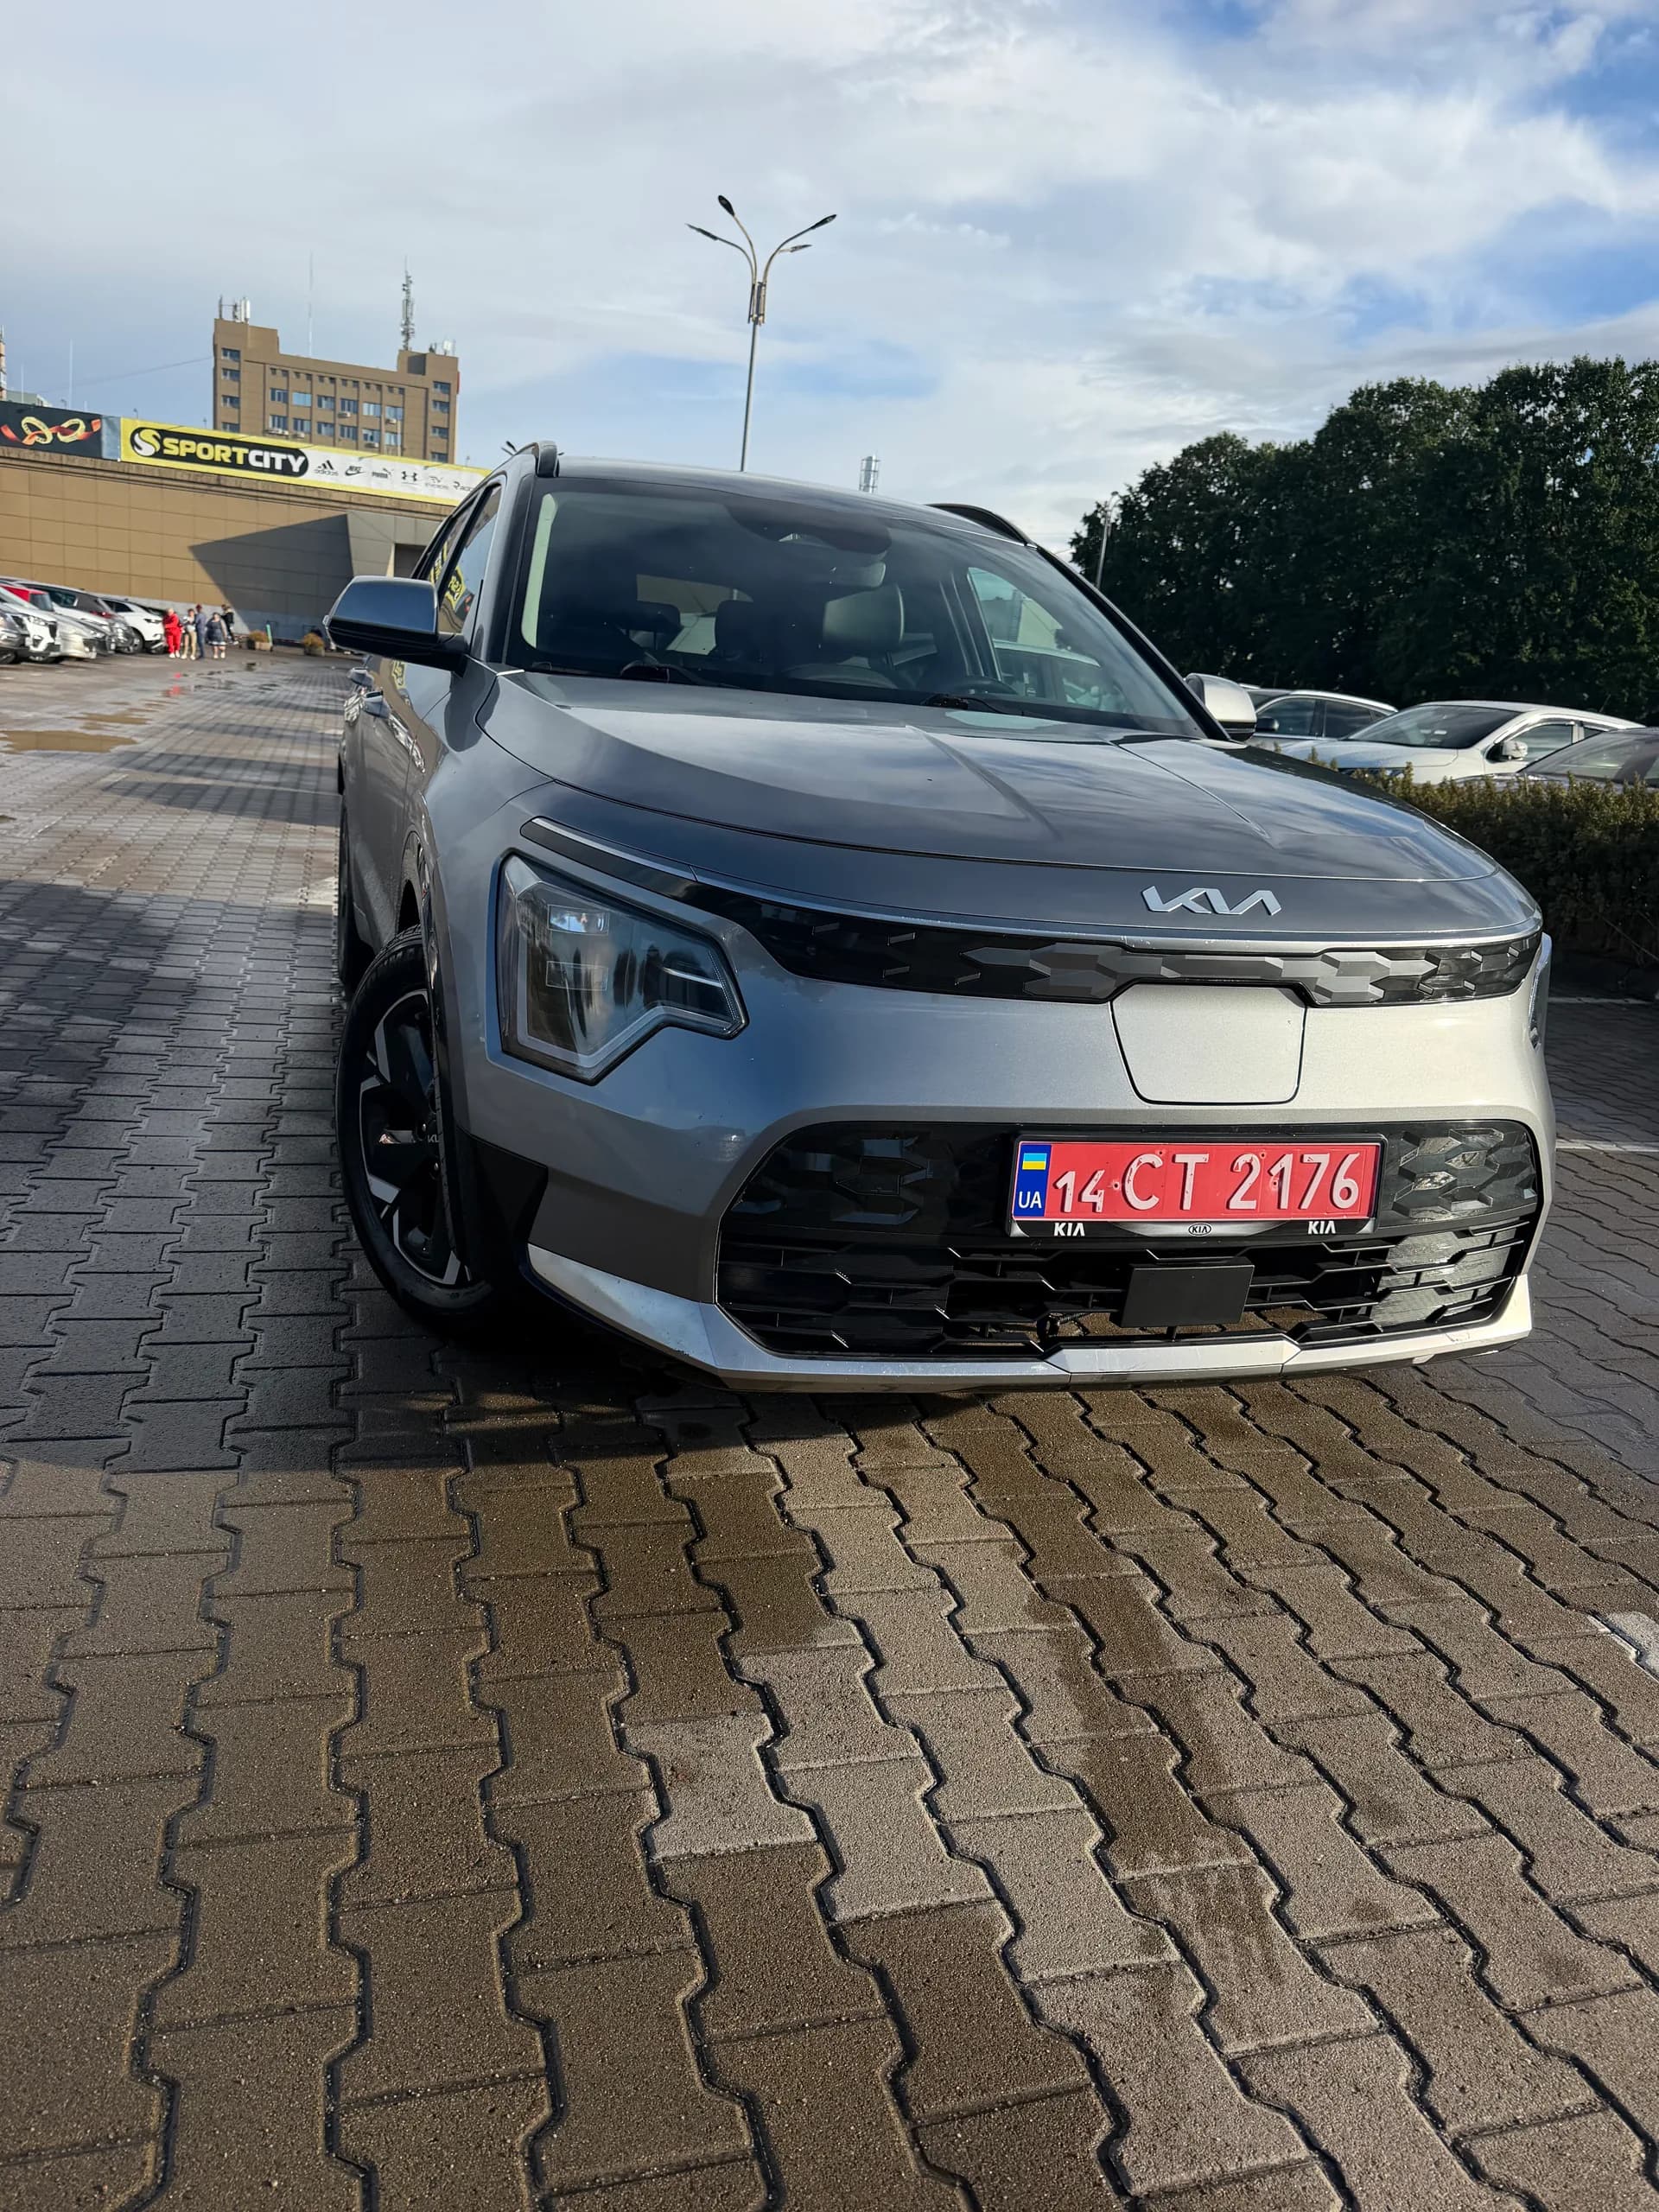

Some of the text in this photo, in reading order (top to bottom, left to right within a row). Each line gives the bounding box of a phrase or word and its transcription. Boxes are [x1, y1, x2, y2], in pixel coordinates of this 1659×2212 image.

[162, 437, 306, 473] SPORTCITY
[1141, 886, 1282, 916] KIA
[1055, 1152, 1361, 1212] 14 CT 2176
[1018, 1191, 1043, 1210] UA
[1052, 1222, 1086, 1237] KIA
[1192, 1225, 1209, 1234] KIA
[1307, 1220, 1338, 1236] KIA
